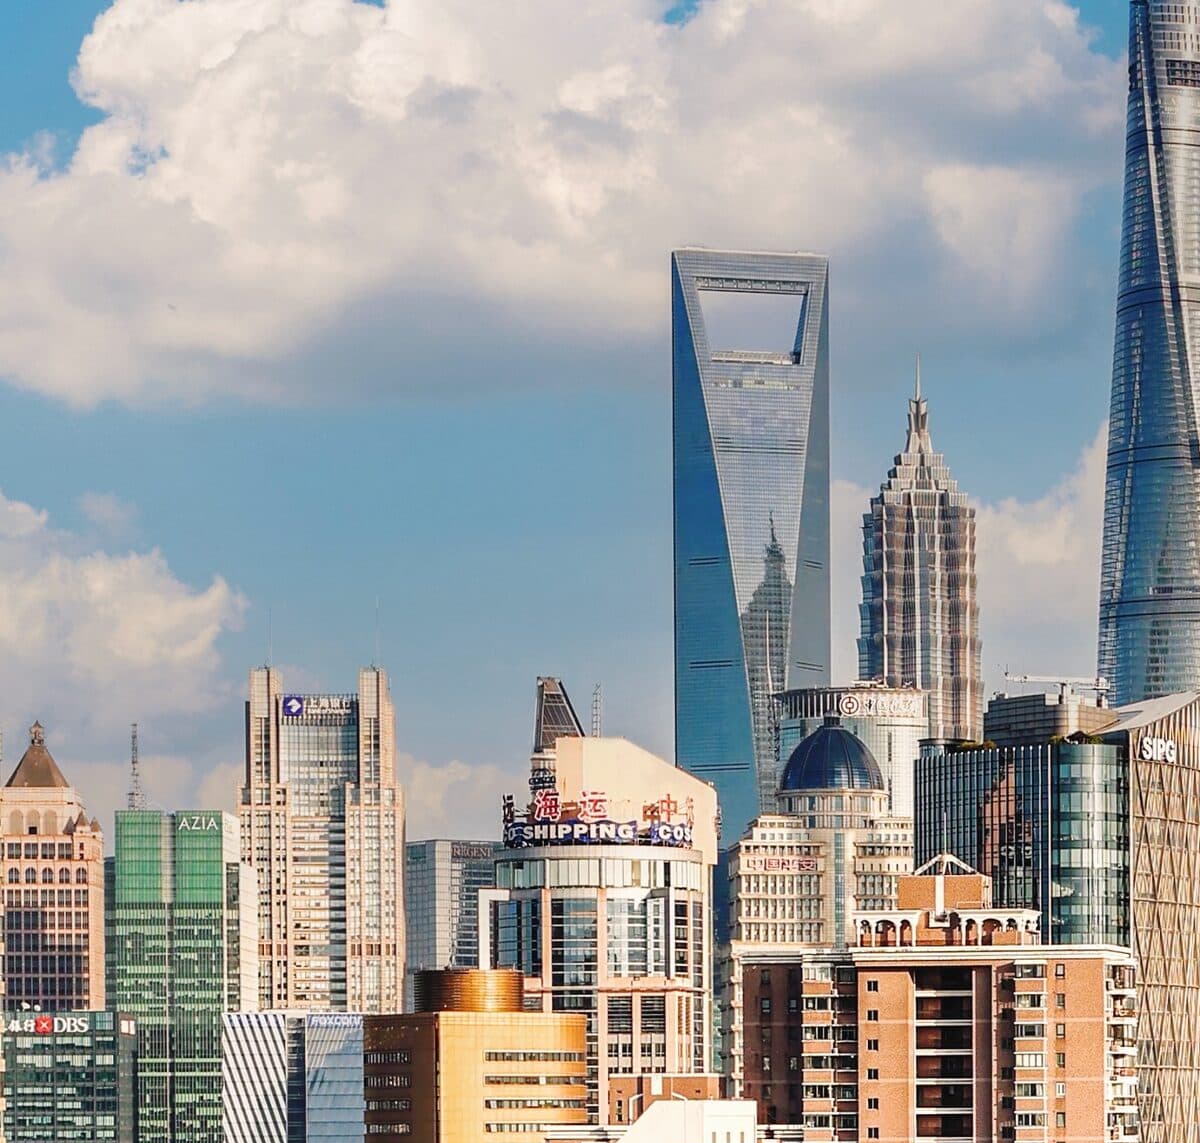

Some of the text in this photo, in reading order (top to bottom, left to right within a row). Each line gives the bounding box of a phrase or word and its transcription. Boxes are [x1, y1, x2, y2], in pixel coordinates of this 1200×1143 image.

[1142, 736, 1176, 763] SIPG
[178, 816, 219, 830] AZIA
[522, 824, 635, 841] SHIPPING
[54, 1017, 89, 1033] DBS
